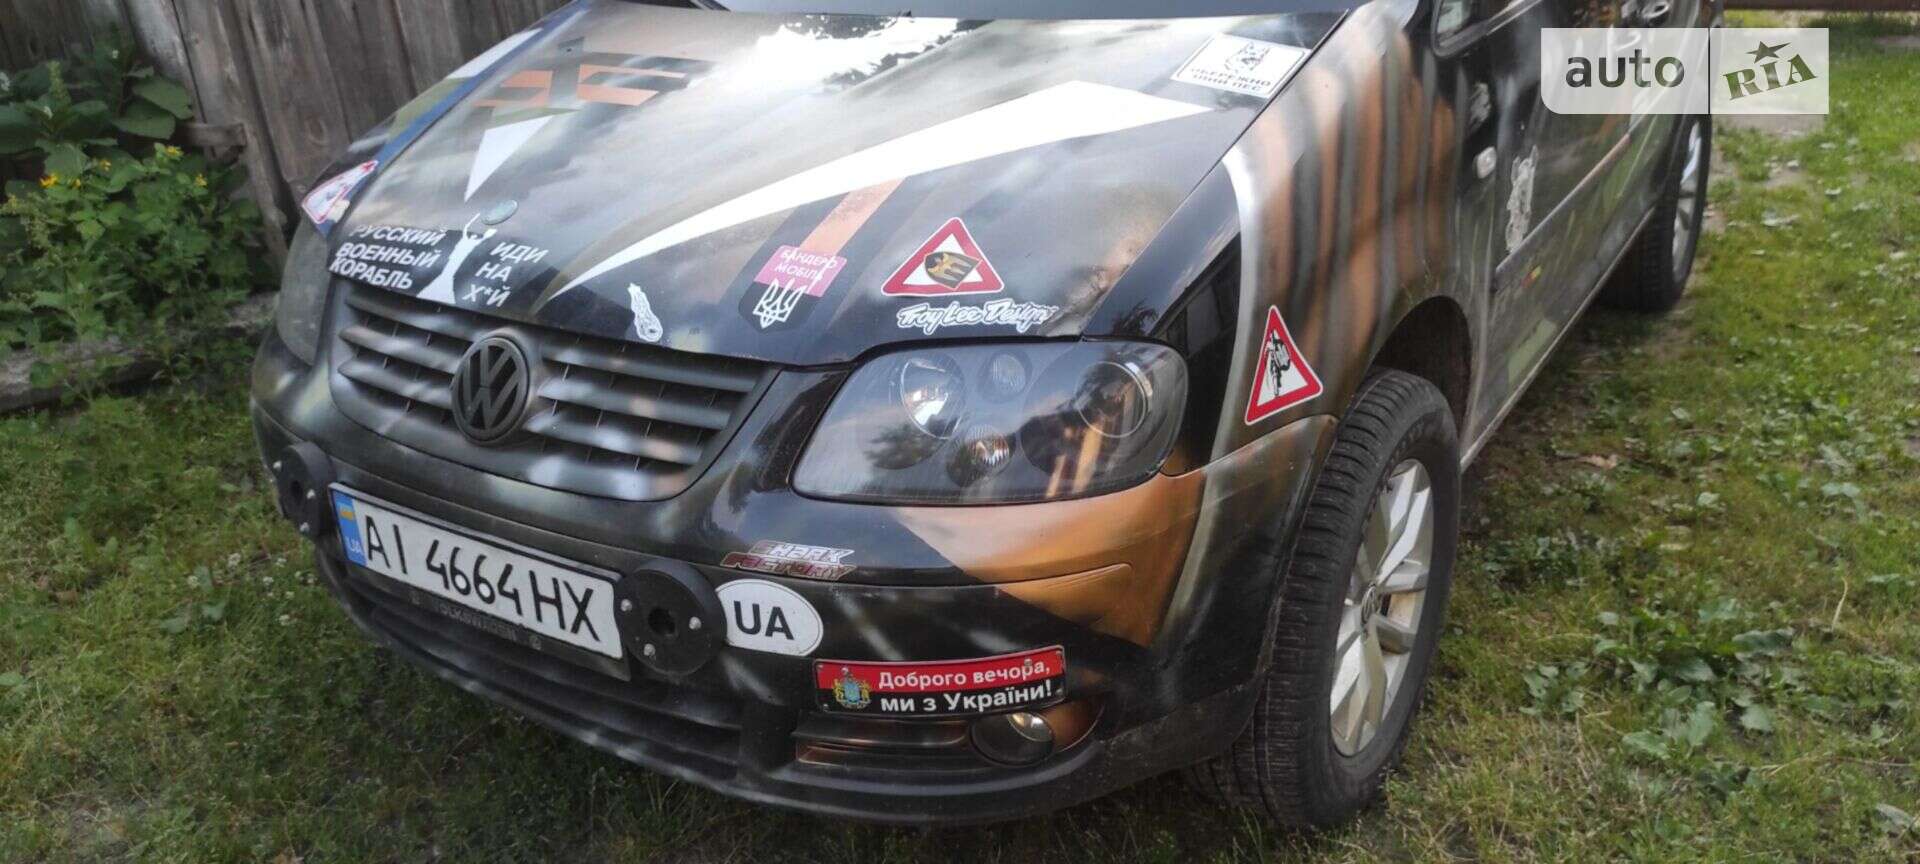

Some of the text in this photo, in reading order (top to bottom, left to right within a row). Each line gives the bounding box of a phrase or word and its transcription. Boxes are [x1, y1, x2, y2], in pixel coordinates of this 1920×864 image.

[350, 225, 446, 246] РУССКИЙ
[335, 242, 441, 268] ВОЕННЫЙ
[489, 241, 549, 264] ИДИ
[328, 257, 413, 290] КОРАБЛЬ
[475, 262, 512, 282] НА
[898, 303, 940, 335] Troy
[942, 301, 983, 326] Lee
[365, 515, 600, 642] AI 4664 HX
[734, 600, 794, 641] UA
[878, 658, 1050, 690] Доброго вечора,
[881, 679, 1052, 712] ми з України!
